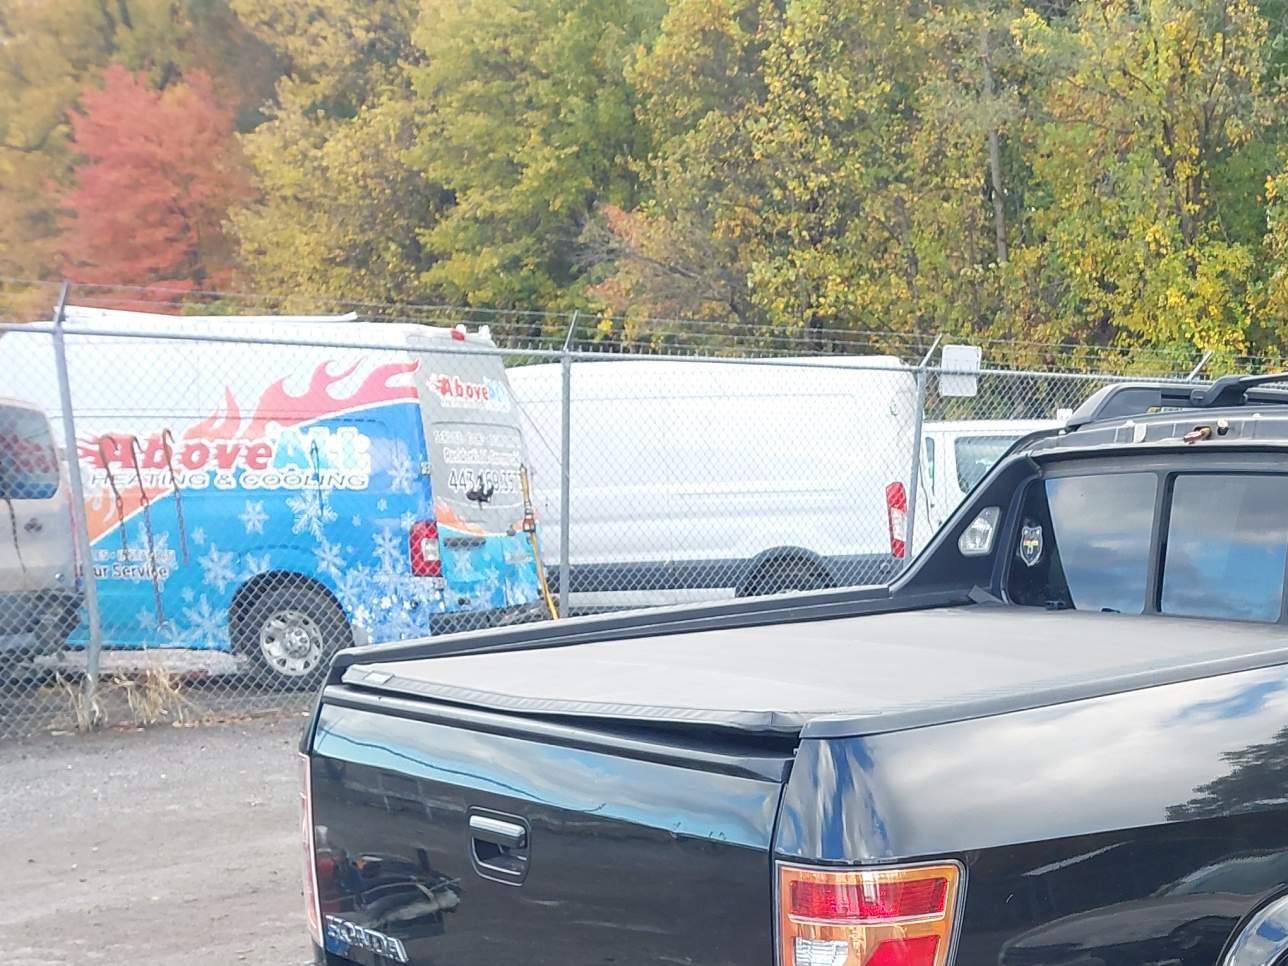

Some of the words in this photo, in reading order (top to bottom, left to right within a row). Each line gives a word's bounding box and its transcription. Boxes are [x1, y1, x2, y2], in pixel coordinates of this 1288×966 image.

[91, 473, 208, 488] HEATING
[214, 473, 237, 488] &
[243, 473, 370, 488] COOLING
[112, 563, 167, 578] Service
[325, 914, 410, 963] HONDA
